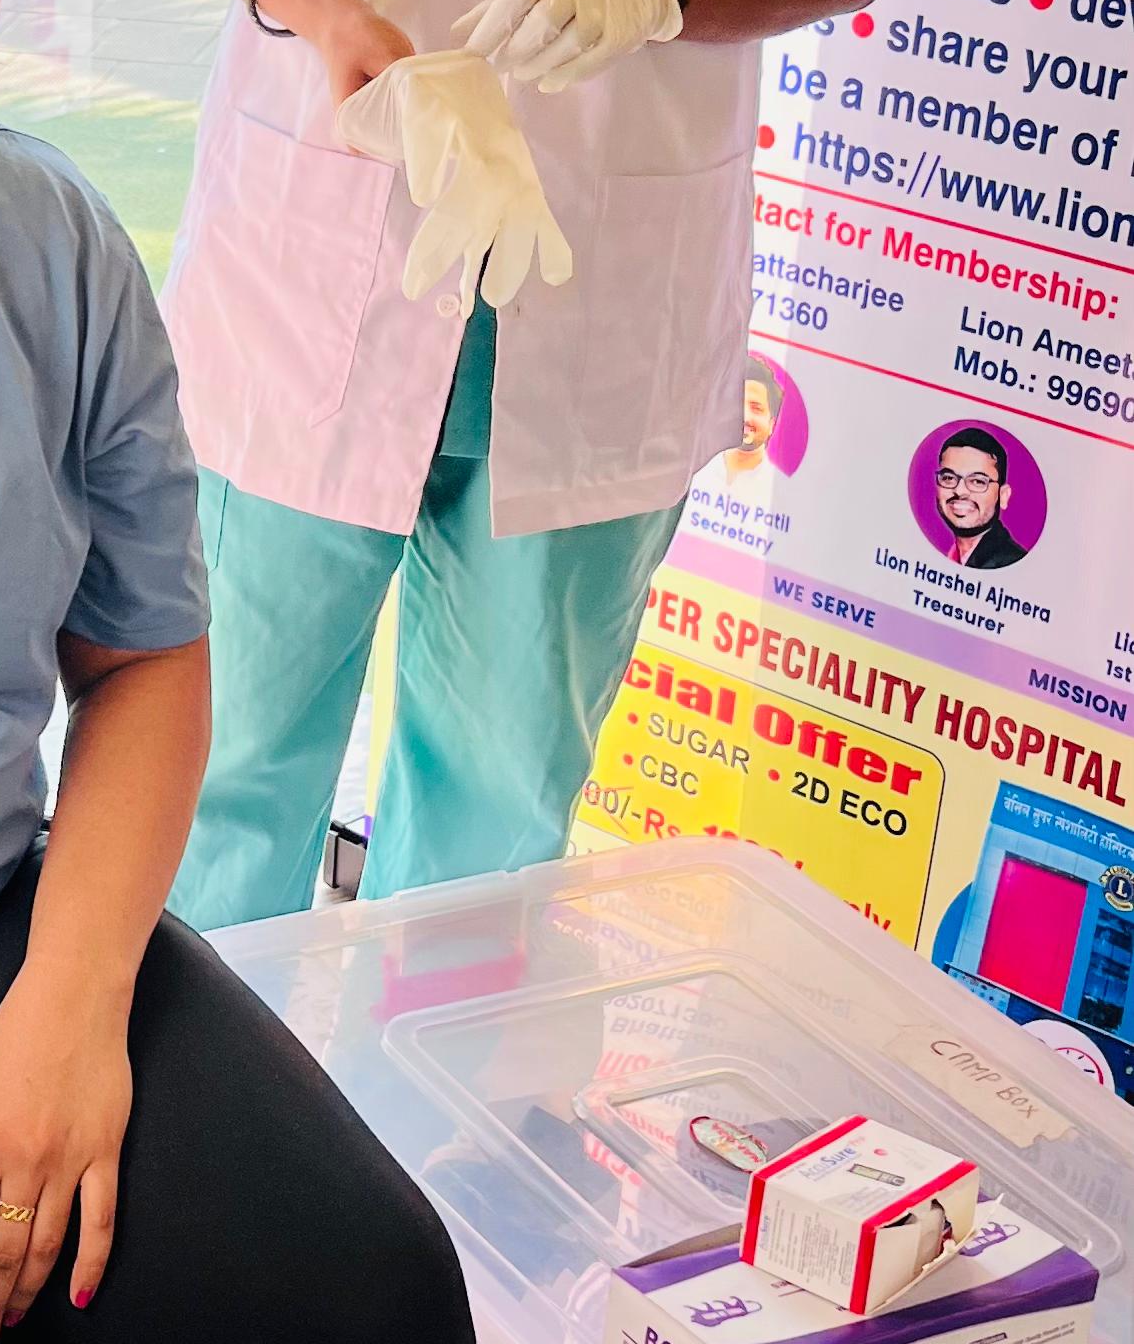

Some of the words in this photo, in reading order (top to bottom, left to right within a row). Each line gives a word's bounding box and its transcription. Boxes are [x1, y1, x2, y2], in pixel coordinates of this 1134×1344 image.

[886, 14, 1010, 75] share
[1022, 48, 1128, 101] your
[778, 52, 828, 102] be
[840, 76, 865, 112] a
[877, 84, 1059, 156] member
[1070, 128, 1120, 171] of
[751, 252, 906, 313] attacharjee
[753, 193, 815, 237] tact
[824, 210, 873, 250] for
[882, 226, 1120, 322] Membership:
[750, 288, 828, 332] 71360
[959, 304, 1024, 348] Lion
[1031, 328, 1134, 380] Ameet
[690, 511, 774, 556] Secretary
[691, 488, 711, 506] on
[714, 493, 750, 524] Ajay
[754, 506, 791, 533] Patil
[773, 576, 805, 603] WE
[810, 591, 877, 630] SERVE
[874, 547, 910, 575] Lion
[914, 559, 983, 600] Harshel
[984, 585, 1051, 625] Ajmera
[912, 588, 1006, 636] Treasurer
[624, 657, 737, 726] cial
[753, 703, 923, 796] Offer
[713, 611, 927, 724] SPECIALITY
[934, 694, 1127, 807] HOSPITAL
[1028, 668, 1128, 723] MISSION
[647, 711, 751, 774] SUGAR
[639, 755, 699, 796] CBC
[791, 770, 831, 805] 2D
[838, 788, 909, 837] ECO
[929, 1039, 1002, 1084] CAMP
